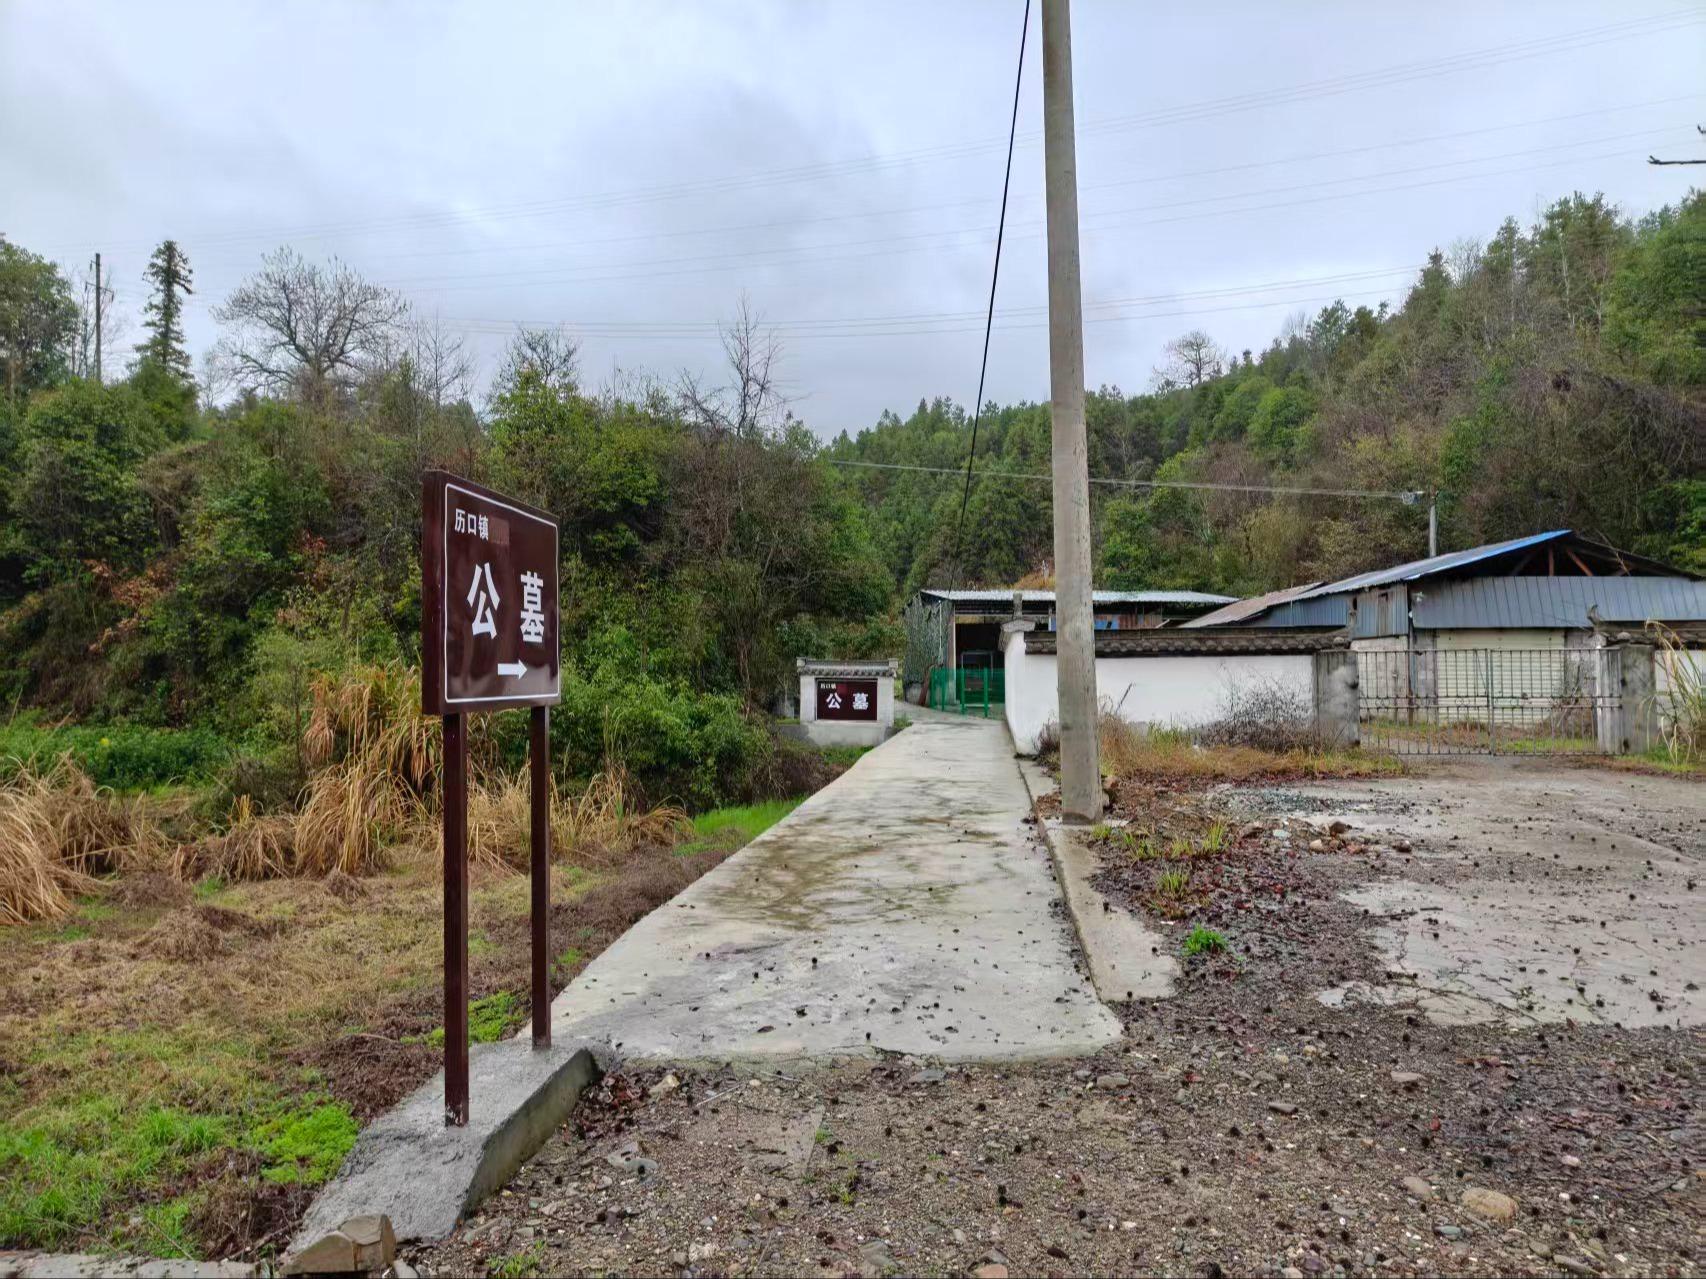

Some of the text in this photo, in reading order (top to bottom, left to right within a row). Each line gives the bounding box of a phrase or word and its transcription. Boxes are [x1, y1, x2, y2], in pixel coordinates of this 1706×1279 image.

[455, 508, 489, 541] 历口镇
[467, 562, 545, 643] 公墓
[826, 692, 869, 711] 公墓
